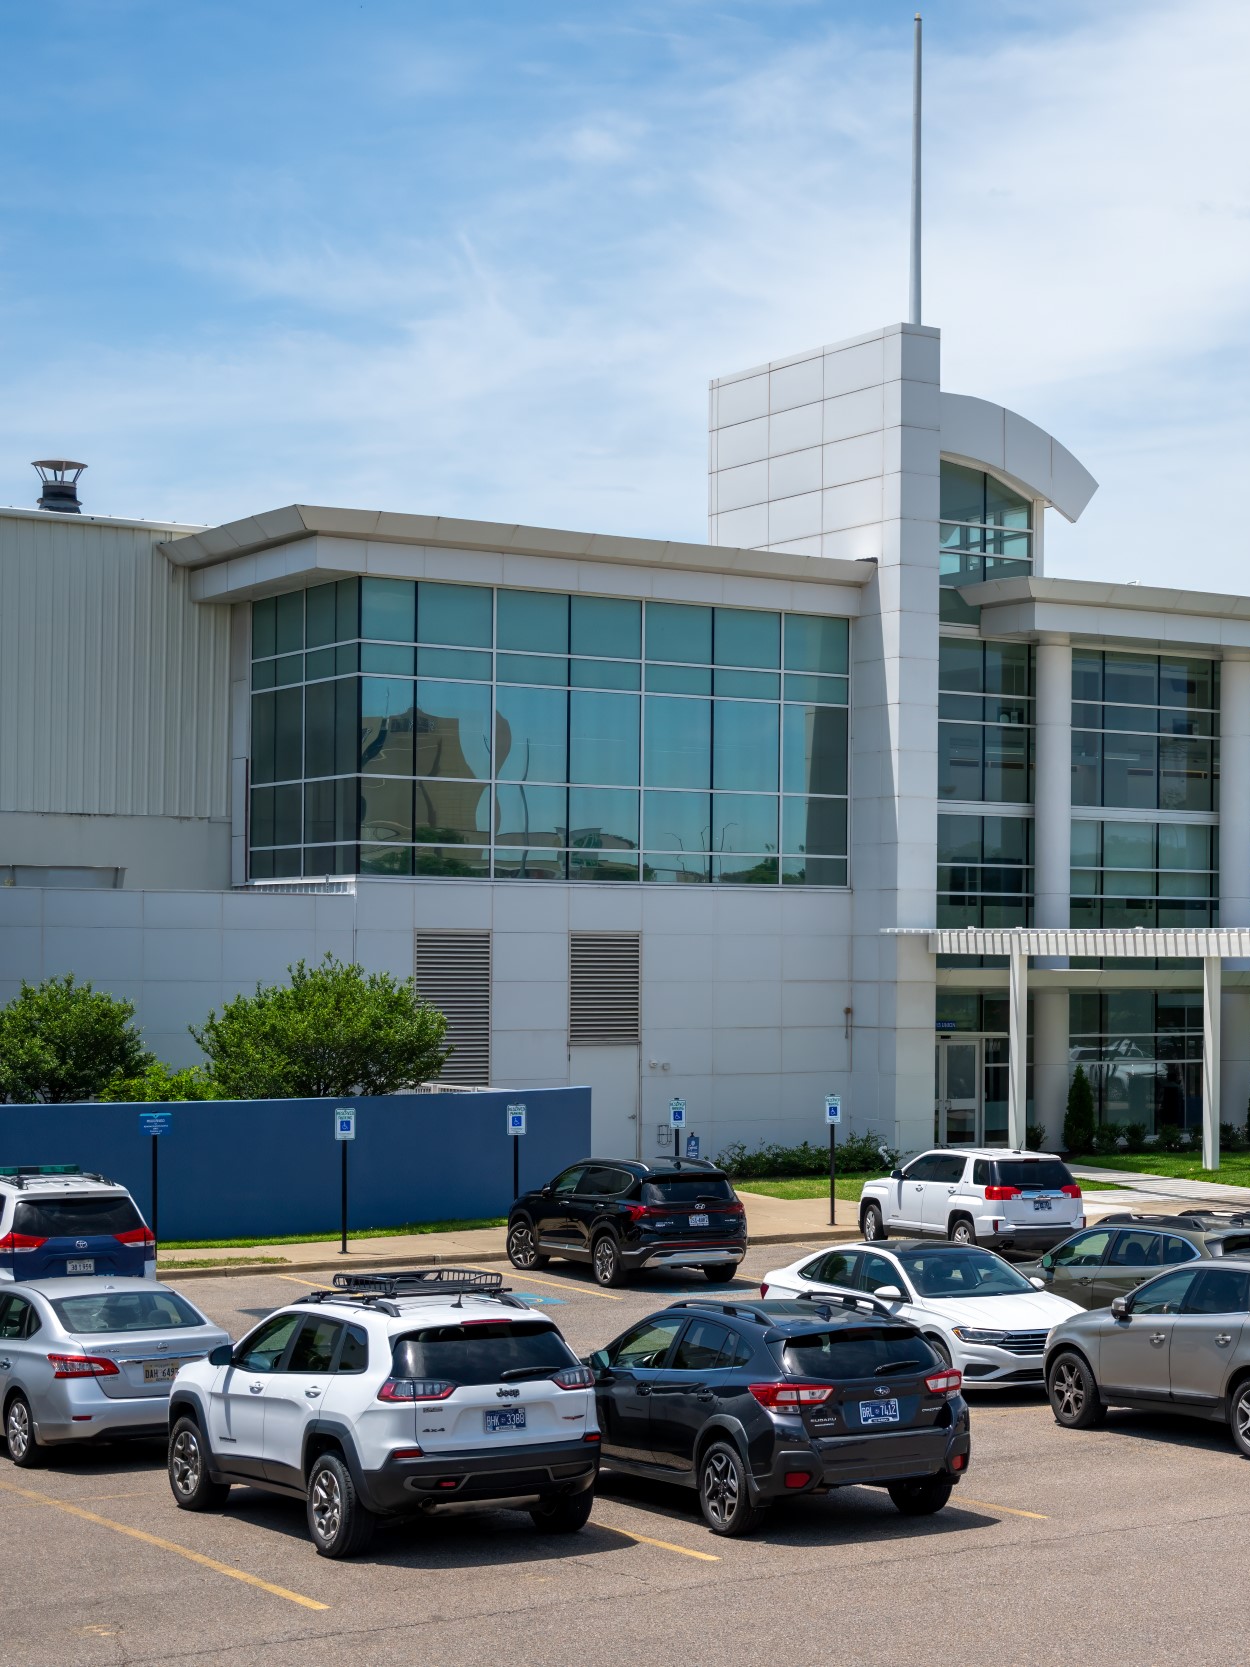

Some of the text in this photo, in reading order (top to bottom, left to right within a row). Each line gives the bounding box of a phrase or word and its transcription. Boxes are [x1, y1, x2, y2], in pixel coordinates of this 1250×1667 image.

[145, 1370, 158, 1379] DAH
[496, 1388, 520, 1398] Jeep
[880, 1405, 896, 1416] 7412
[487, 1413, 524, 1426] BHK 3388
